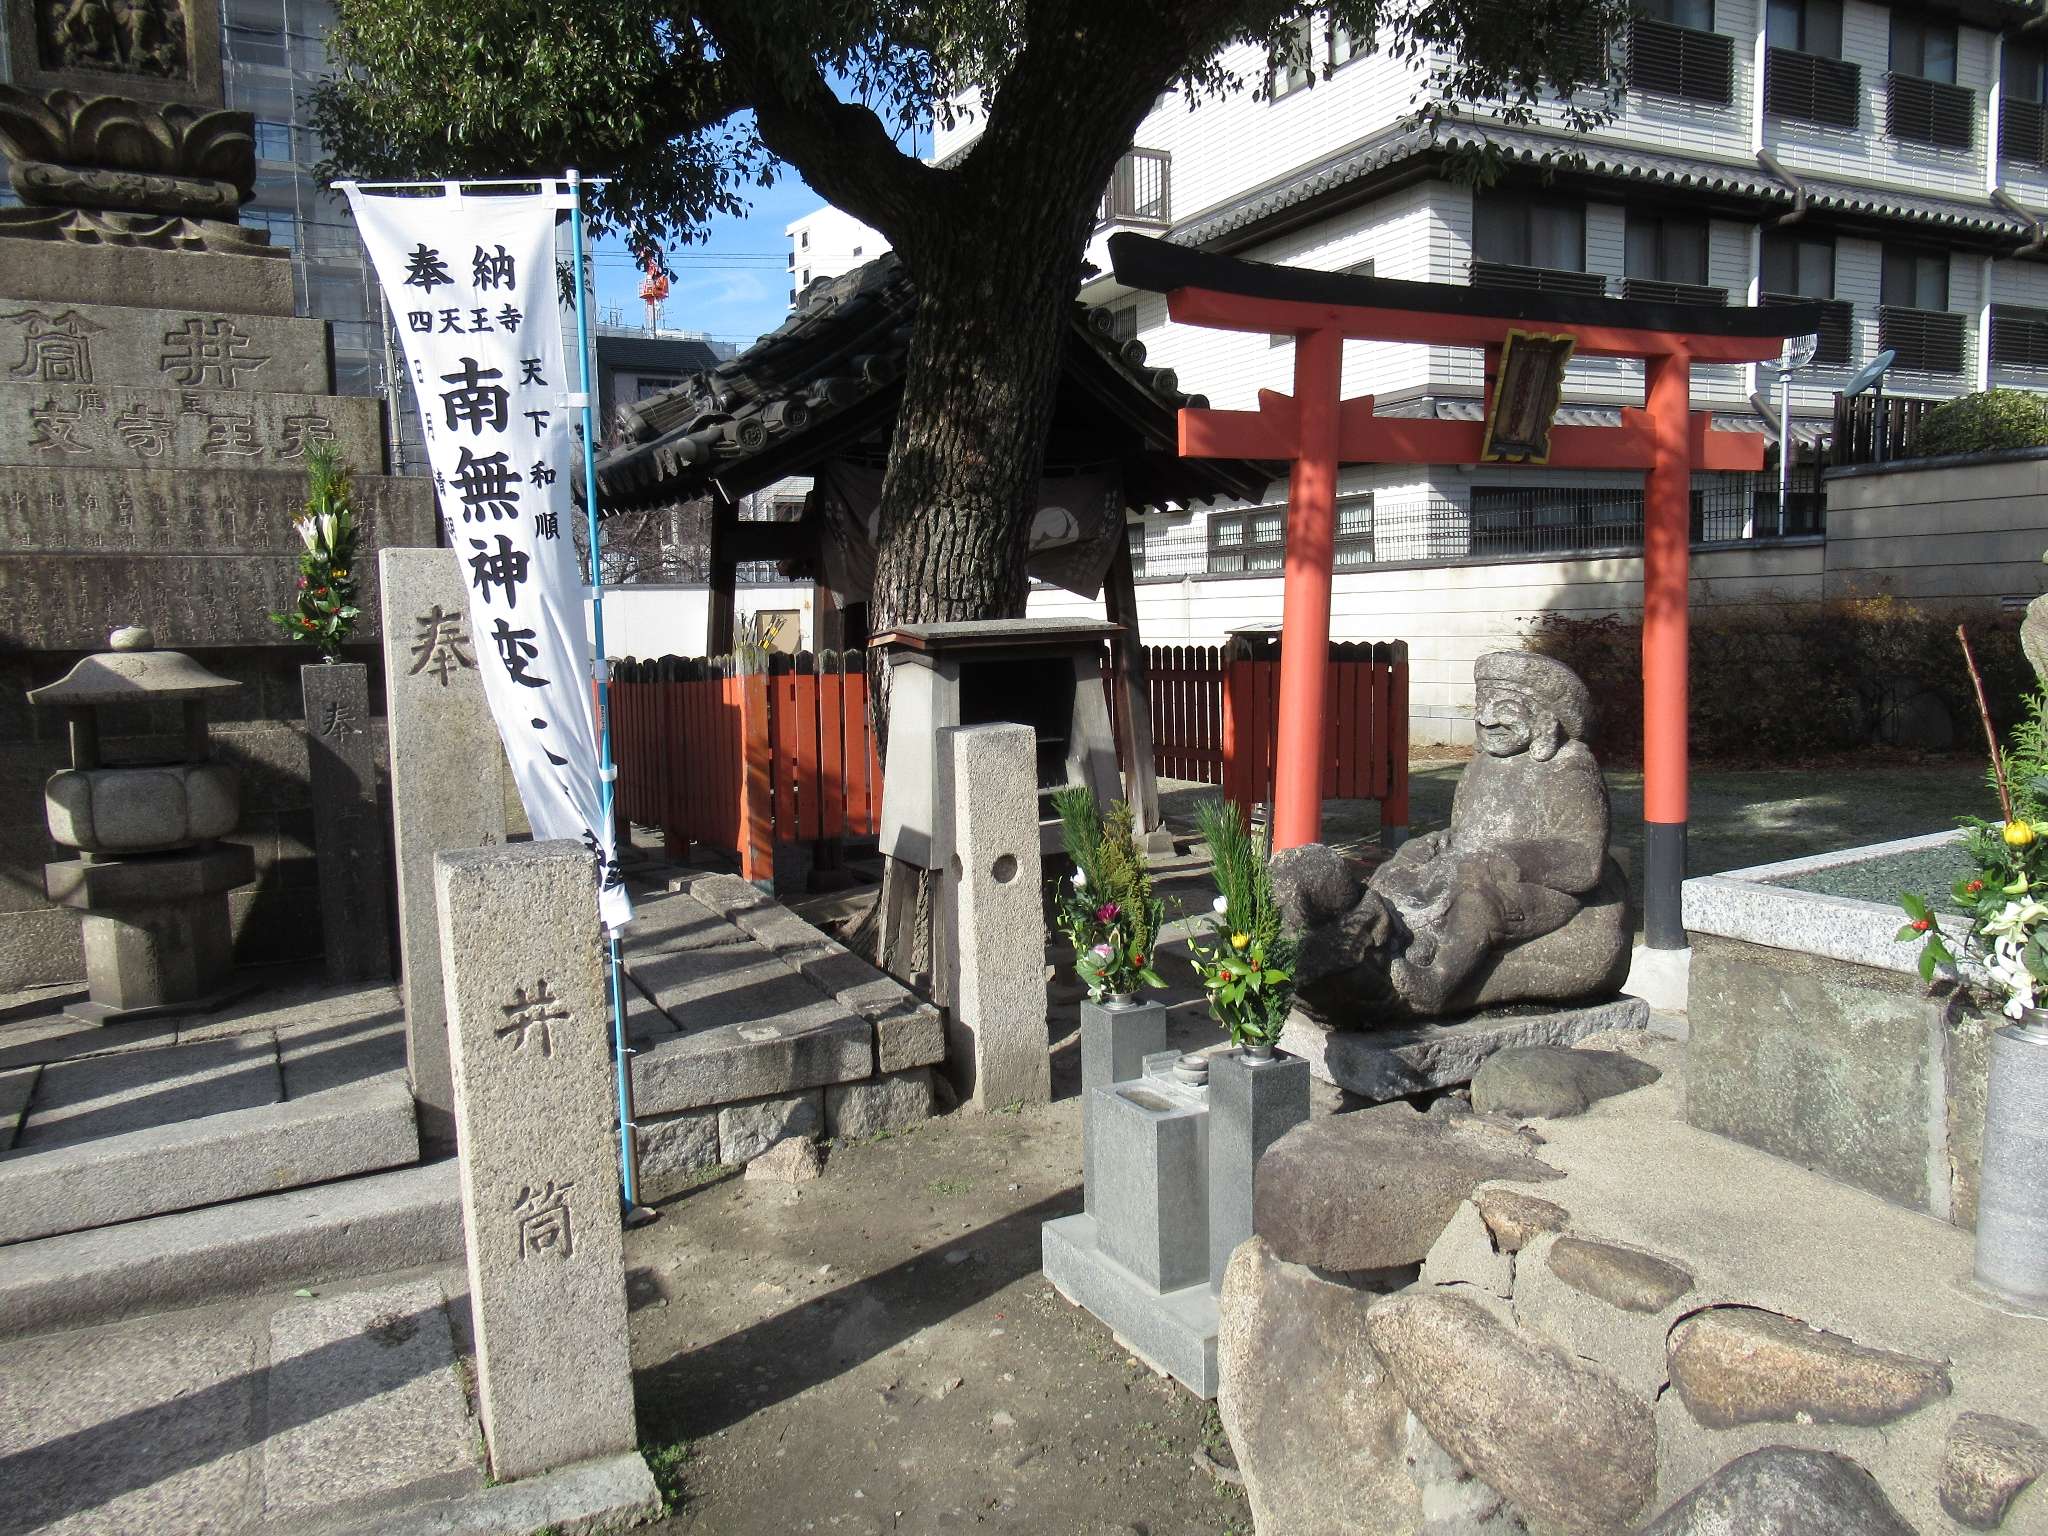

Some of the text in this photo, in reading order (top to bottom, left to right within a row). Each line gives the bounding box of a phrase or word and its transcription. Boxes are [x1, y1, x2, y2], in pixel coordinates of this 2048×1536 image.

[403, 243, 516, 294] 奉納
[407, 303, 523, 334] 四天王寺
[519, 357, 563, 541] 天下和順
[408, 604, 480, 687] 奉
[496, 979, 576, 1262] 井筒
